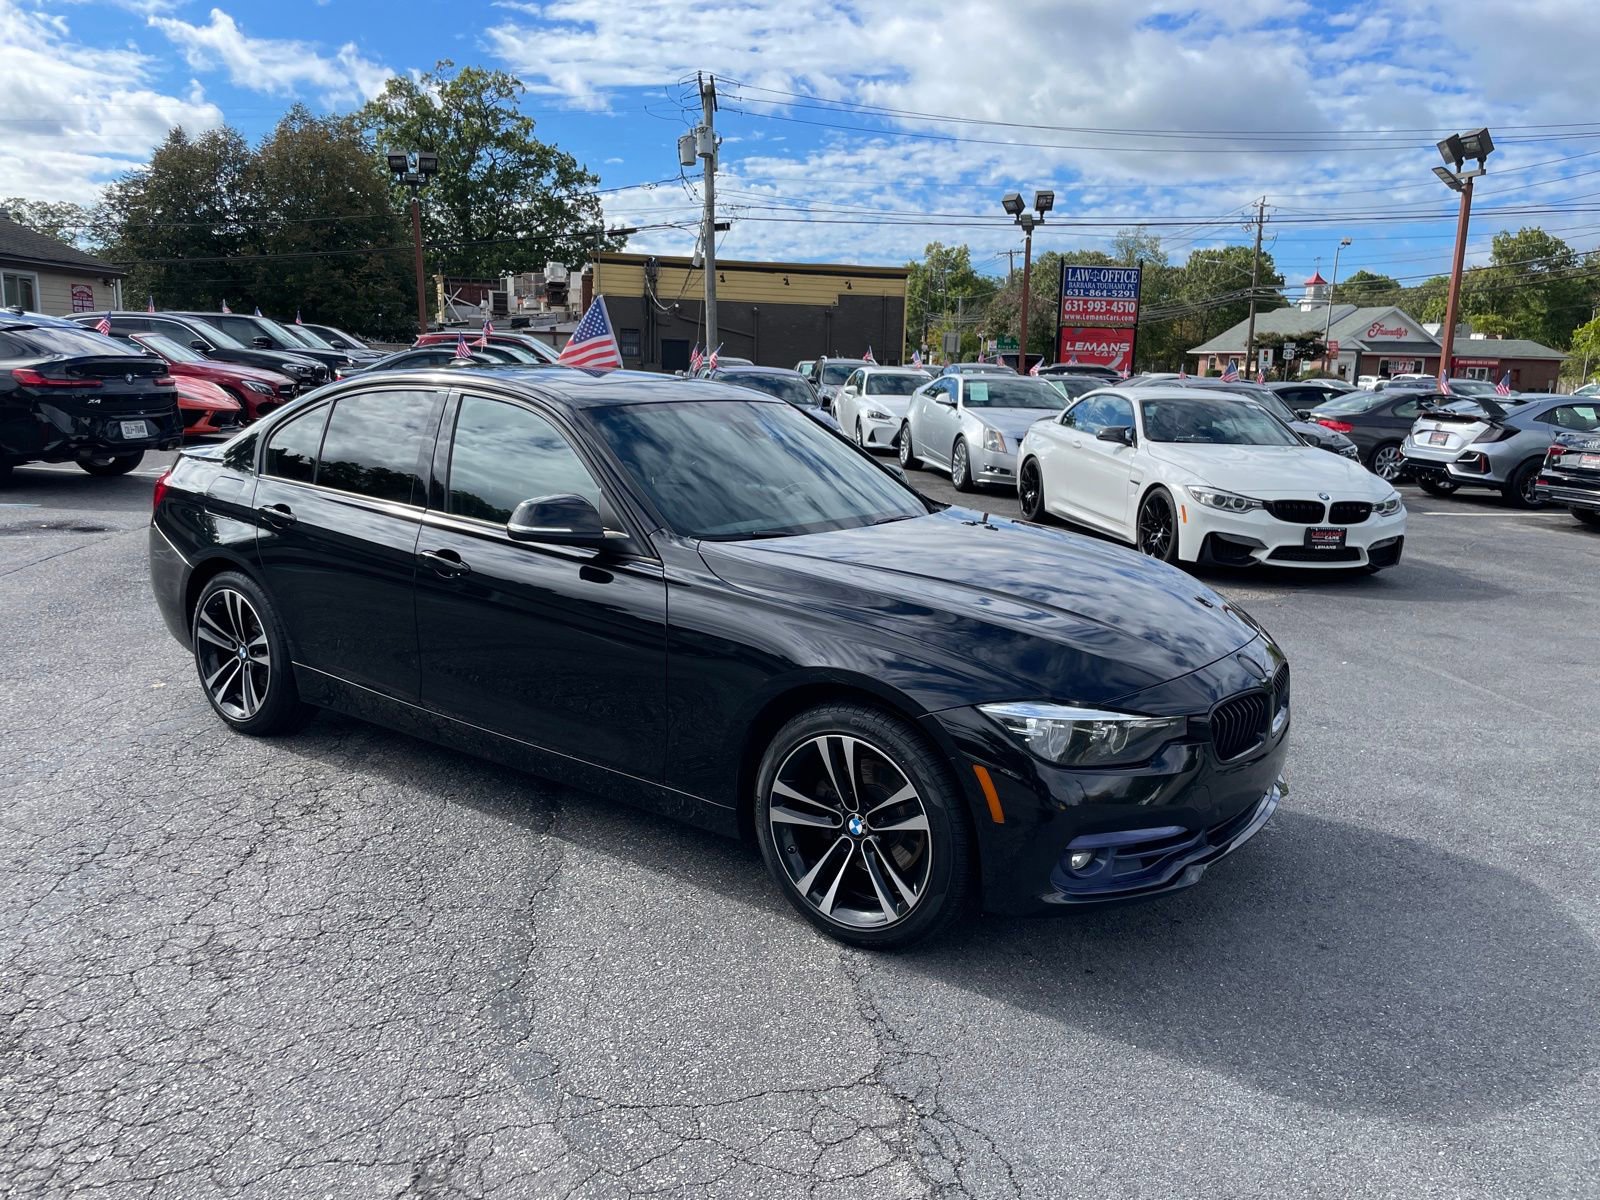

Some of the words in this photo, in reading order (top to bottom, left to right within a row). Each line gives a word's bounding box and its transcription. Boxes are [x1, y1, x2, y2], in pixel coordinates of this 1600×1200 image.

[1068, 269, 1091, 282] LAW
[1100, 270, 1138, 283] OFFICE
[1066, 289, 1135, 298] 631-864-5291
[1065, 300, 1136, 313] 631-993-4510
[1064, 314, 1134, 322] www.LemansCars.com
[1066, 342, 1130, 352] LEMANS
